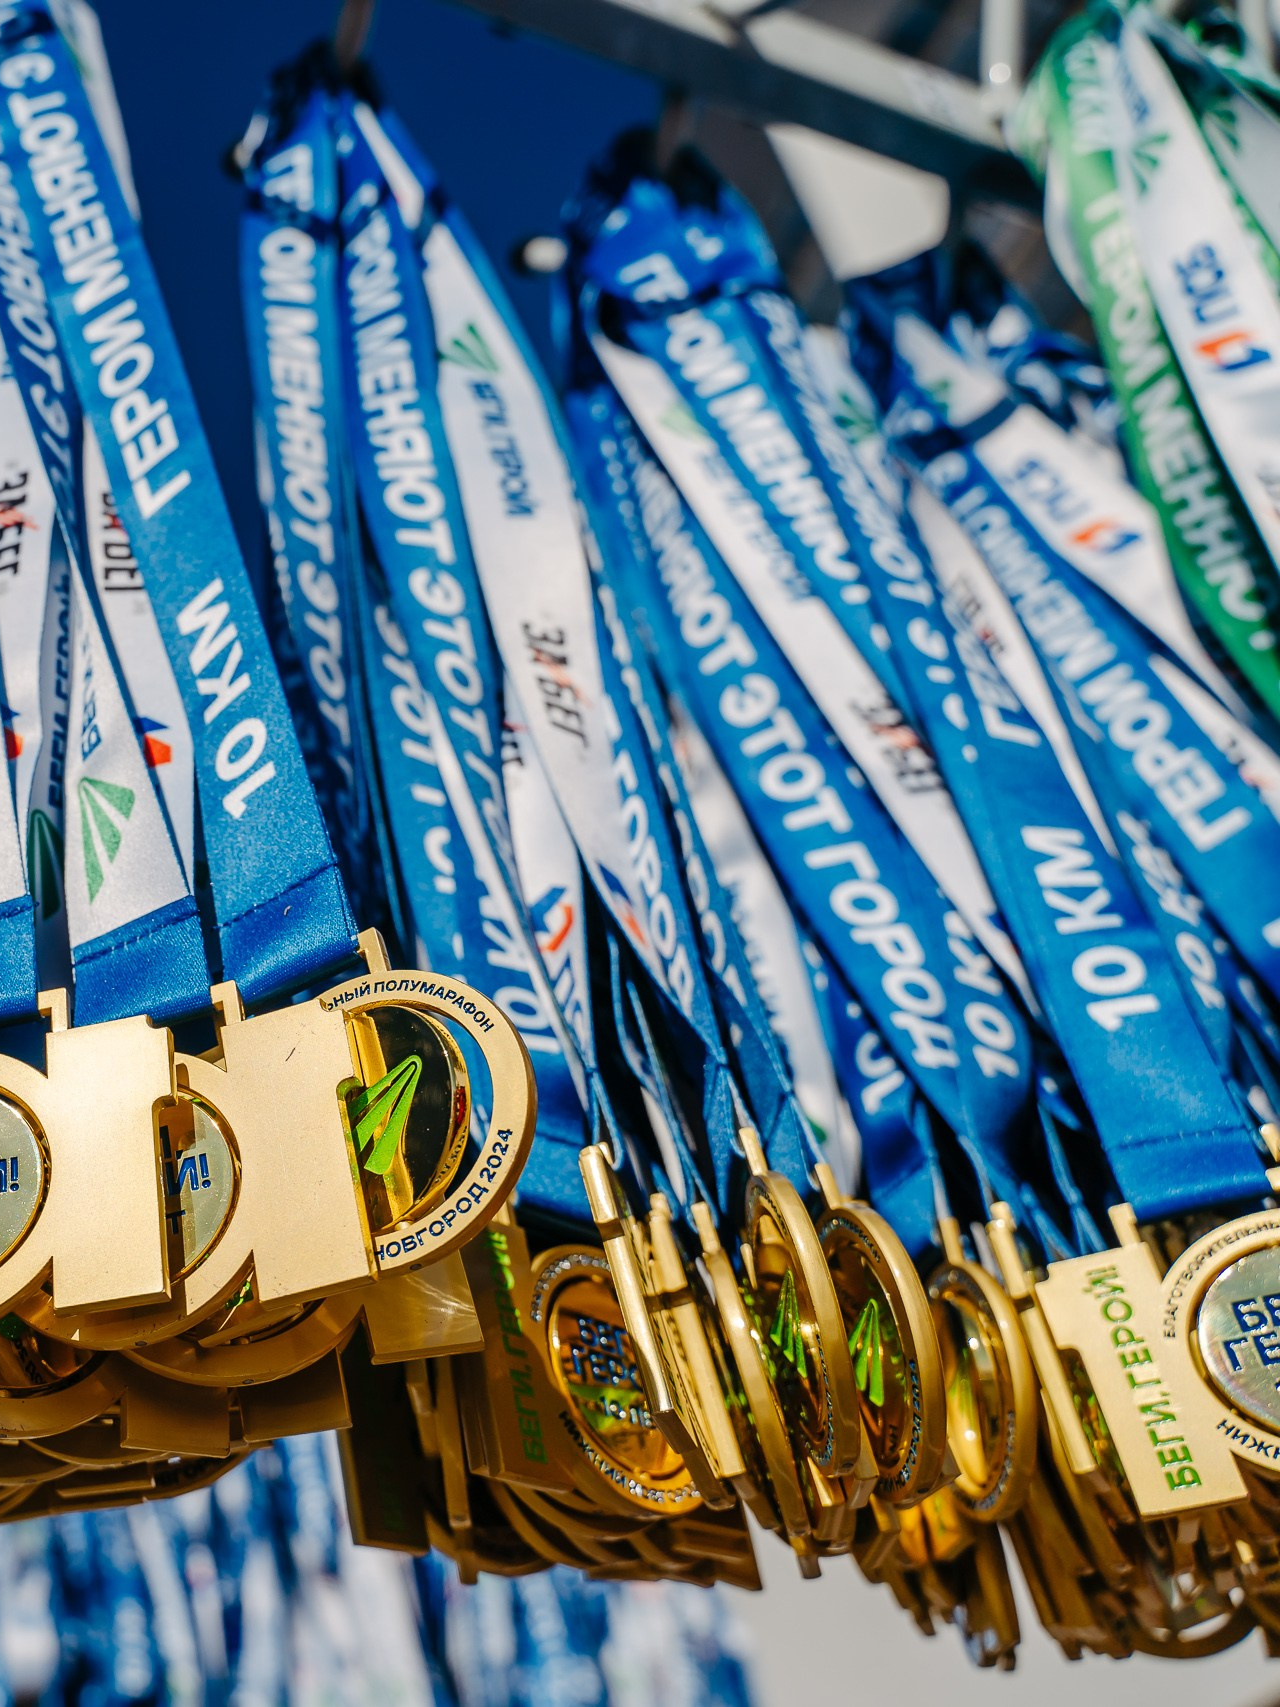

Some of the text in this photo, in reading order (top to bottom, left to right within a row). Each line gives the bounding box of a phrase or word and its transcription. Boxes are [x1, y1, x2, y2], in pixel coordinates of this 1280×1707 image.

[7, 91, 132, 315] МЕНЯЮТ
[81, 298, 192, 520] ГЕРОИ
[352, 311, 457, 564] МЕНЯЮТ
[407, 565, 494, 756] ЭТОТ
[176, 578, 251, 722] КМ
[297, 560, 351, 748] ЭТОТ
[215, 718, 276, 819] 10
[1078, 662, 1253, 854] ГЕРОИ
[720, 672, 853, 833] ЭТОТ
[803, 840, 961, 1069] ГОРОД
[1020, 825, 1161, 1033] 10 КМ
[373, 979, 496, 1034] ПОЛУМАРАФОН
[963, 1001, 1019, 1078] 10
[1174, 931, 1227, 1011] 10
[377, 1182, 489, 1260] НОВГОРОД
[480, 1128, 514, 1182] 2024
